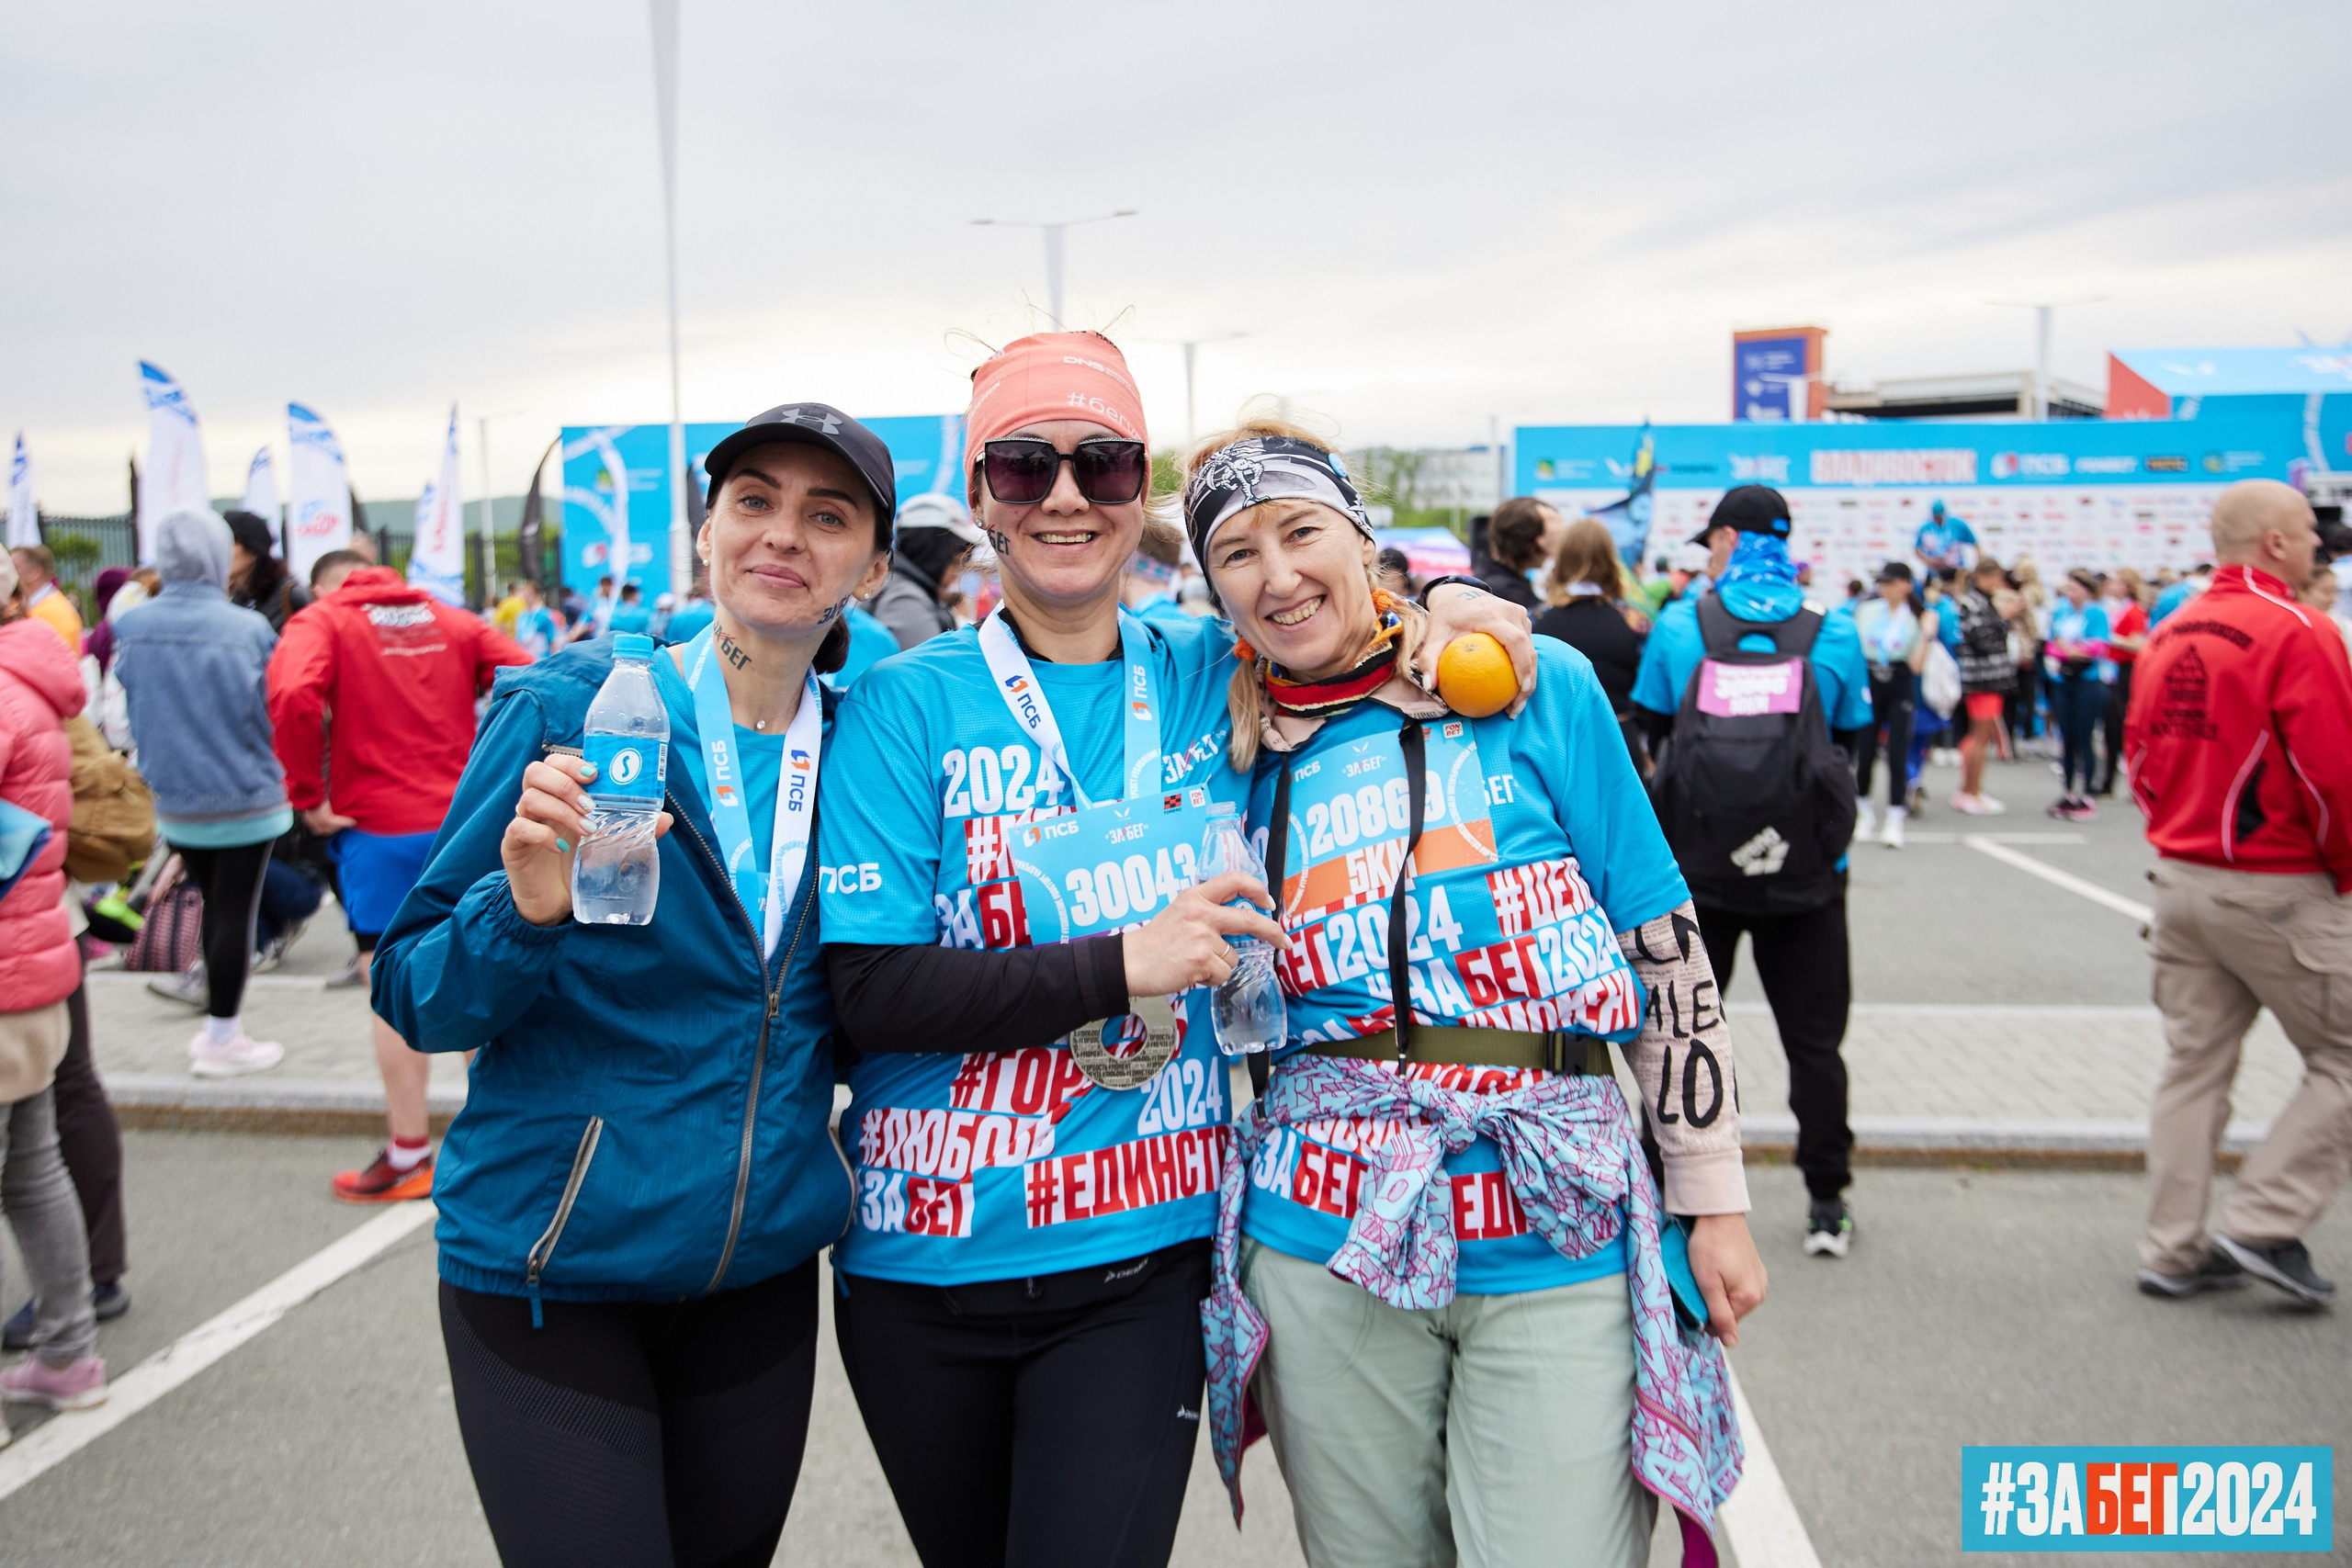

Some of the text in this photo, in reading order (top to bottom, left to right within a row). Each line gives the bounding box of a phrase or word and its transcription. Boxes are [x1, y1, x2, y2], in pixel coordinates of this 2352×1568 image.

[1063, 355, 1105, 372] DNS
[1133, 664, 1147, 699] ПСБ
[1017, 693, 1042, 729] ПСБ
[1445, 723, 1461, 732] FON
[1446, 728, 1461, 737] BET
[711, 739, 732, 781] ПСБ
[1295, 761, 1321, 783] ПСБ
[788, 773, 806, 812] ПСБ
[943, 744, 1066, 818] 2024
[1193, 797, 1204, 806] BET
[1306, 770, 1446, 858] 20869
[1045, 820, 1080, 840] ПСБ
[819, 862, 882, 895] ПСБ
[1065, 842, 1197, 927] 30043
[1136, 1055, 1224, 1137] 2024
